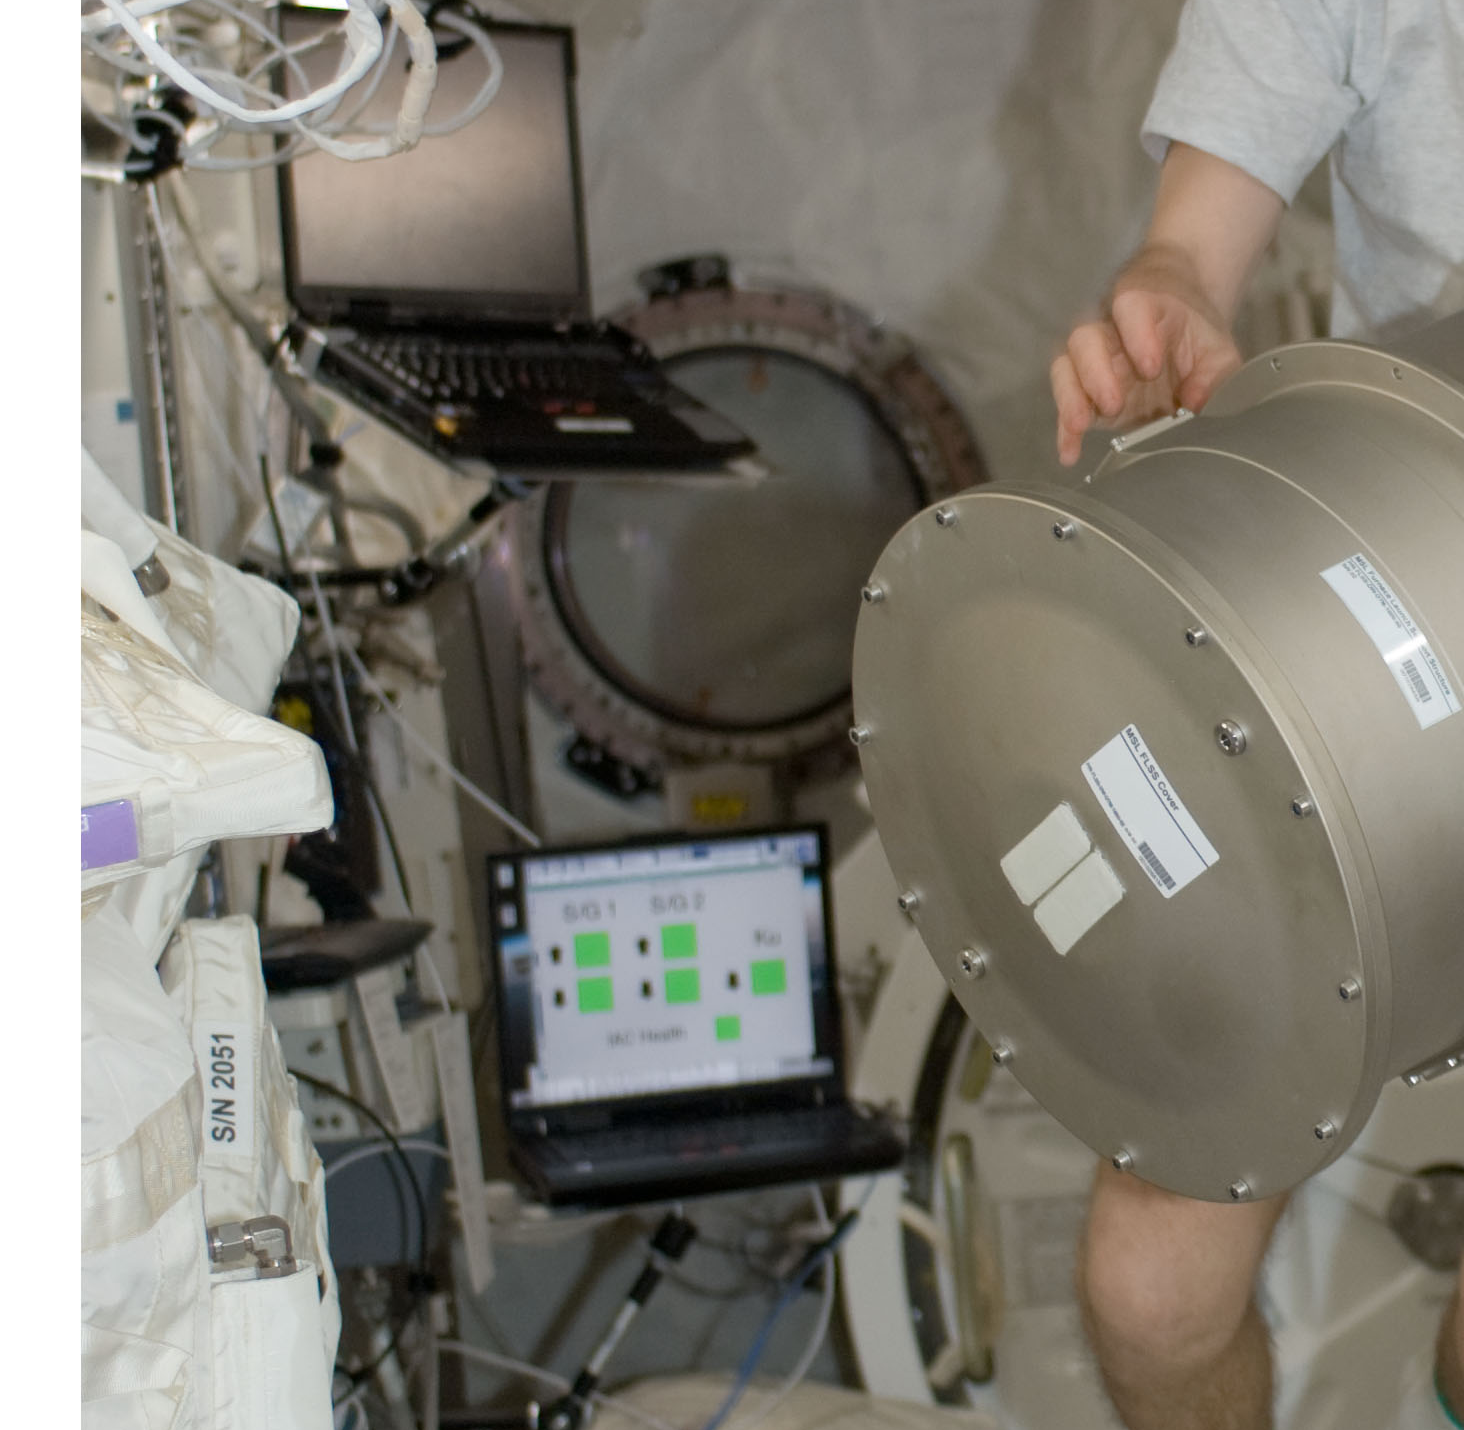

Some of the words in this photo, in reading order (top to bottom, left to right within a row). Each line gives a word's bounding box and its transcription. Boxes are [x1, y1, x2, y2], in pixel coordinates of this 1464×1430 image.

[1125, 727, 1141, 753] MSL
[1138, 751, 1161, 781] FLSS
[1156, 780, 1181, 812] Cover
[211, 1032, 236, 1090] 2051
[211, 1099, 236, 1143] S/N
